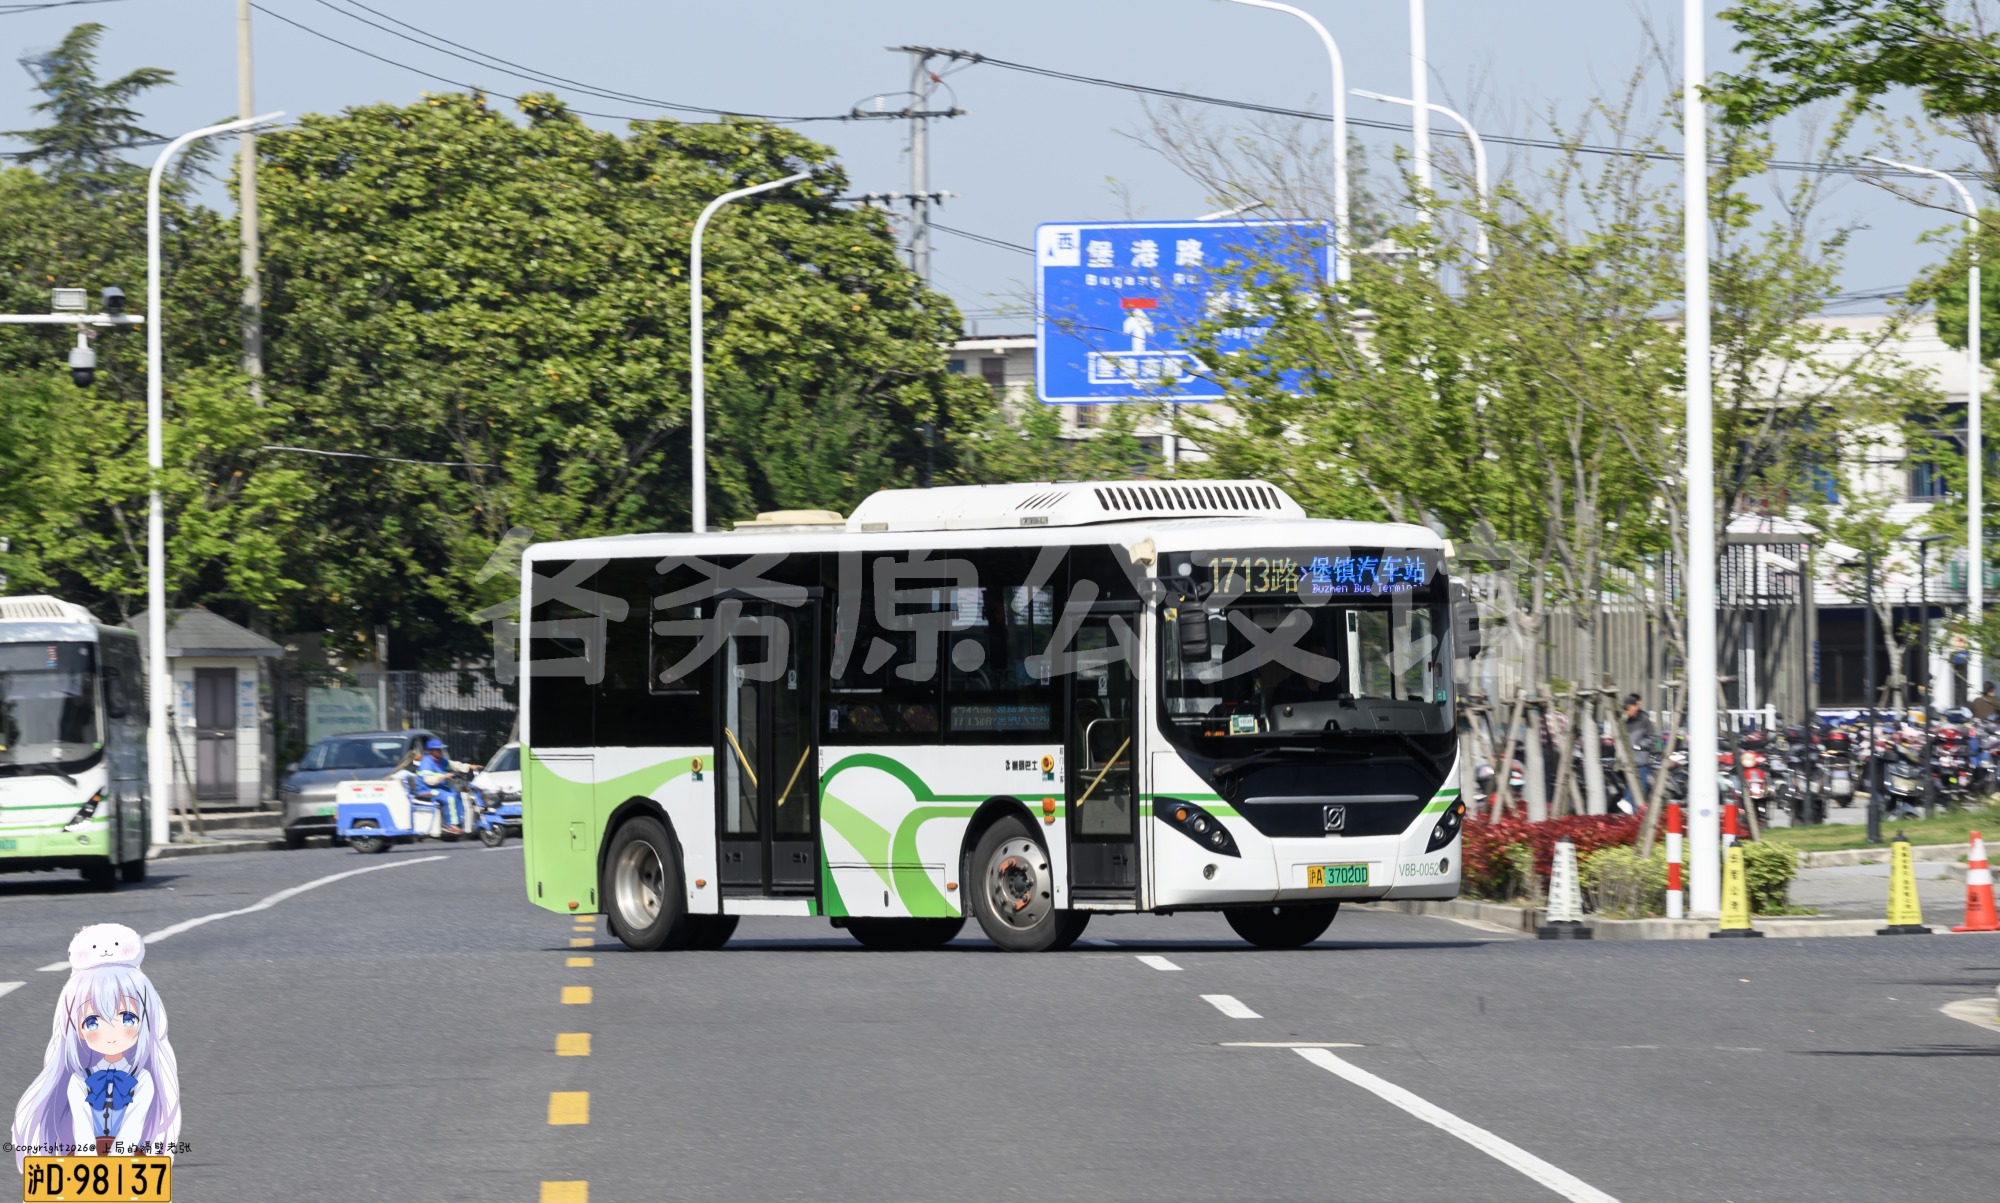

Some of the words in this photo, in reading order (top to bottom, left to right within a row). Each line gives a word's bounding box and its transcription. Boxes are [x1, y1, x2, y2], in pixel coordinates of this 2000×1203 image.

[1057, 232, 1074, 250] 西
[1086, 238, 1205, 268] 堡港路
[1209, 556, 1300, 594] 1713路
[1309, 555, 1426, 583] 堡镇汽车站
[1312, 583, 1348, 593] Buzhen
[1354, 583, 1371, 593] Bus
[1399, 862, 1439, 877] V8B-0052
